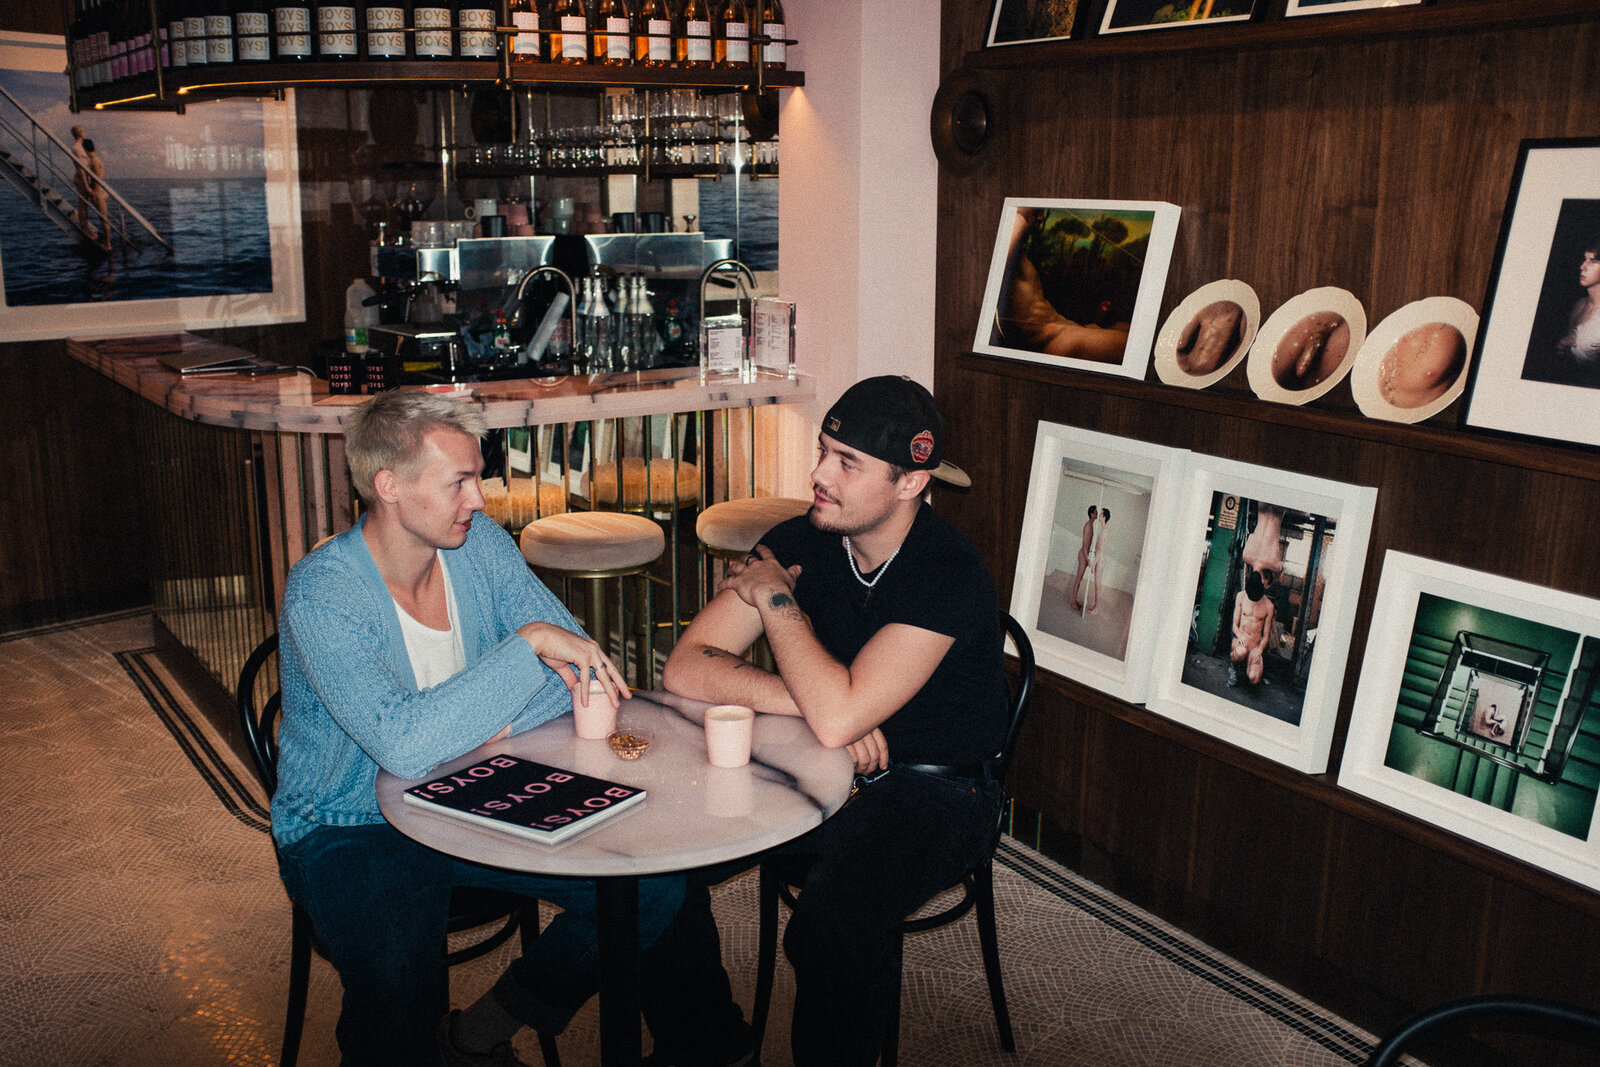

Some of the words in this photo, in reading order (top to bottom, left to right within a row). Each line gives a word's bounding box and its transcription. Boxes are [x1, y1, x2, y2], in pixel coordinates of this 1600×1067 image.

[238, 15, 267, 26] OYS!
[279, 10, 308, 21] OYS!
[368, 10, 402, 21] BOYS
[415, 10, 449, 21] BOYS
[460, 11, 493, 22] BOYS
[239, 40, 268, 52] OYS!
[279, 35, 309, 47] OYS!
[369, 35, 404, 46] BOYS
[416, 35, 450, 47] BOYS
[461, 36, 494, 48] BOYS
[413, 757, 518, 799] BOYS!
[470, 772, 575, 816] BOYS!
[530, 787, 633, 829] BOYS!
